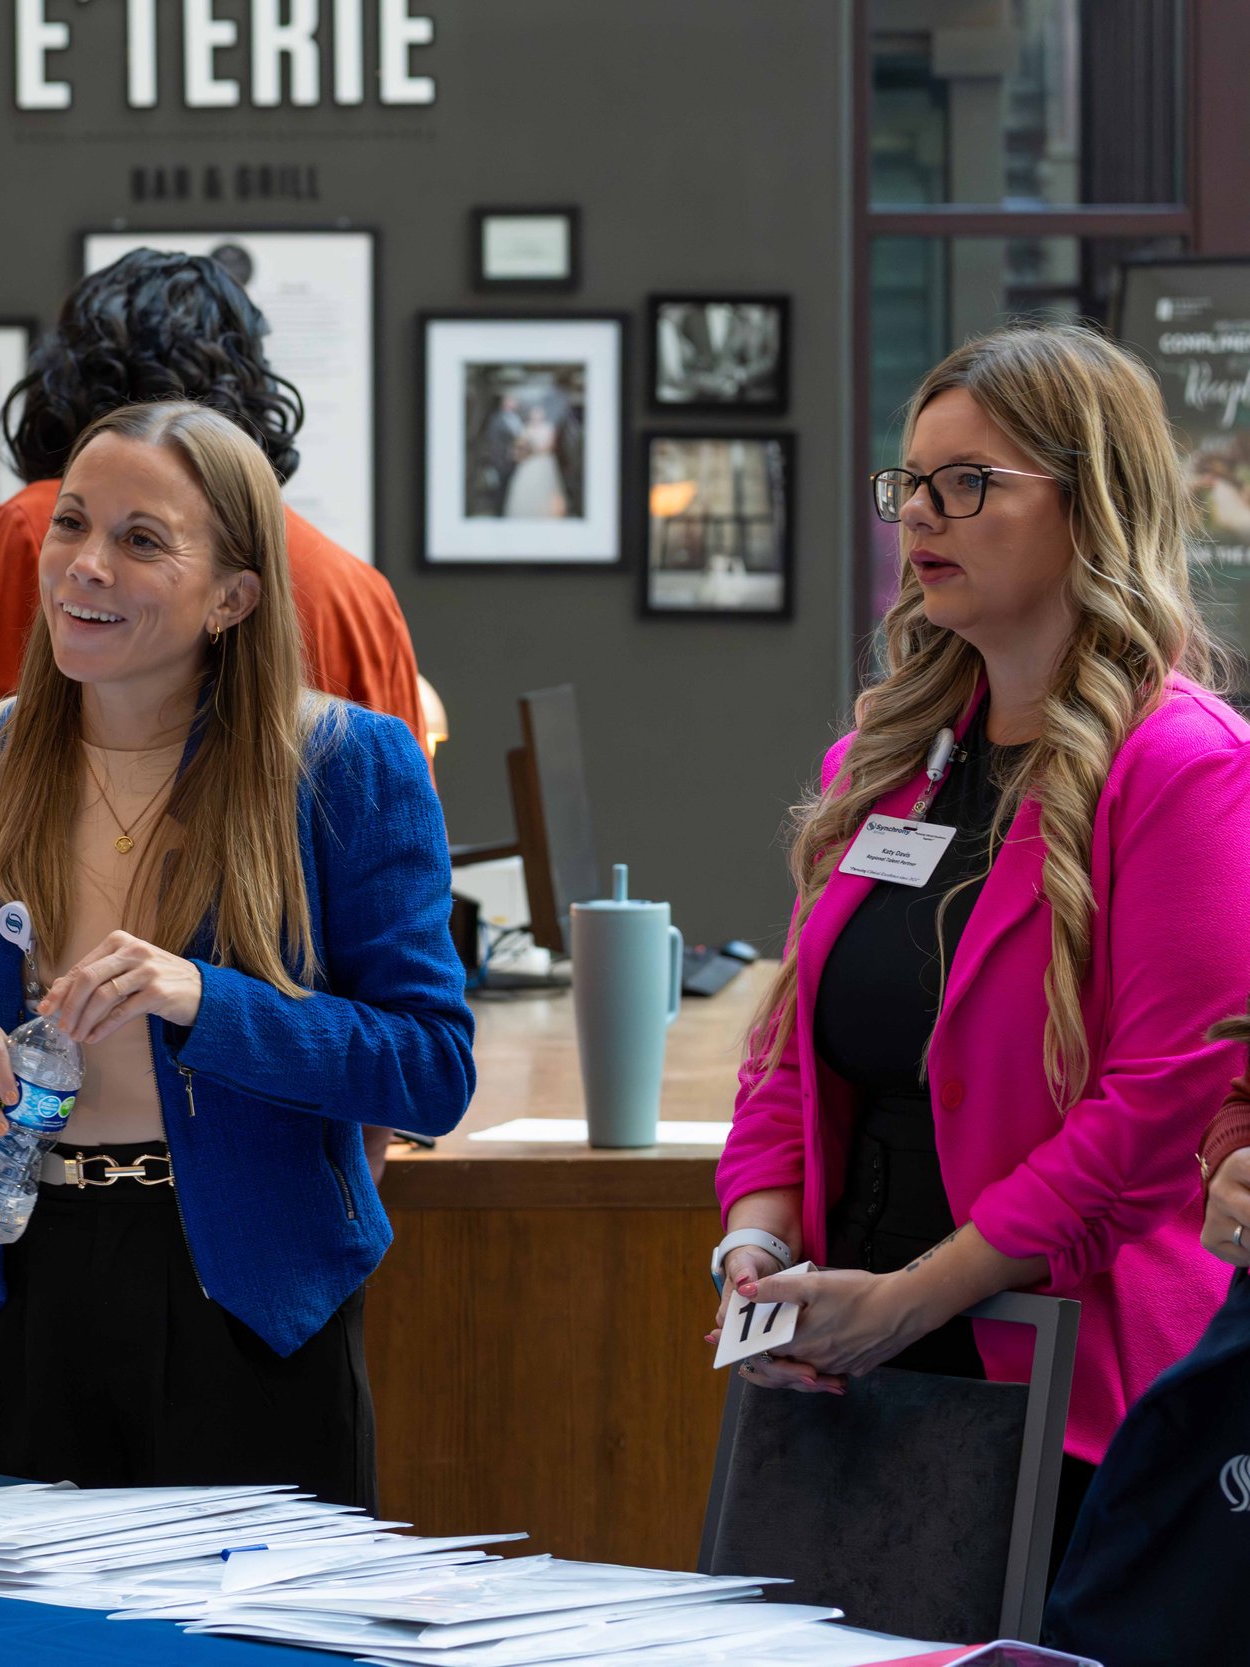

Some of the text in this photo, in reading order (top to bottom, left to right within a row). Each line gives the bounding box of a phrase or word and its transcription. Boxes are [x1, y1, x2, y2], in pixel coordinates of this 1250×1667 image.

[876, 824, 911, 836] Synchrony
[882, 848, 911, 858] Katy Davis
